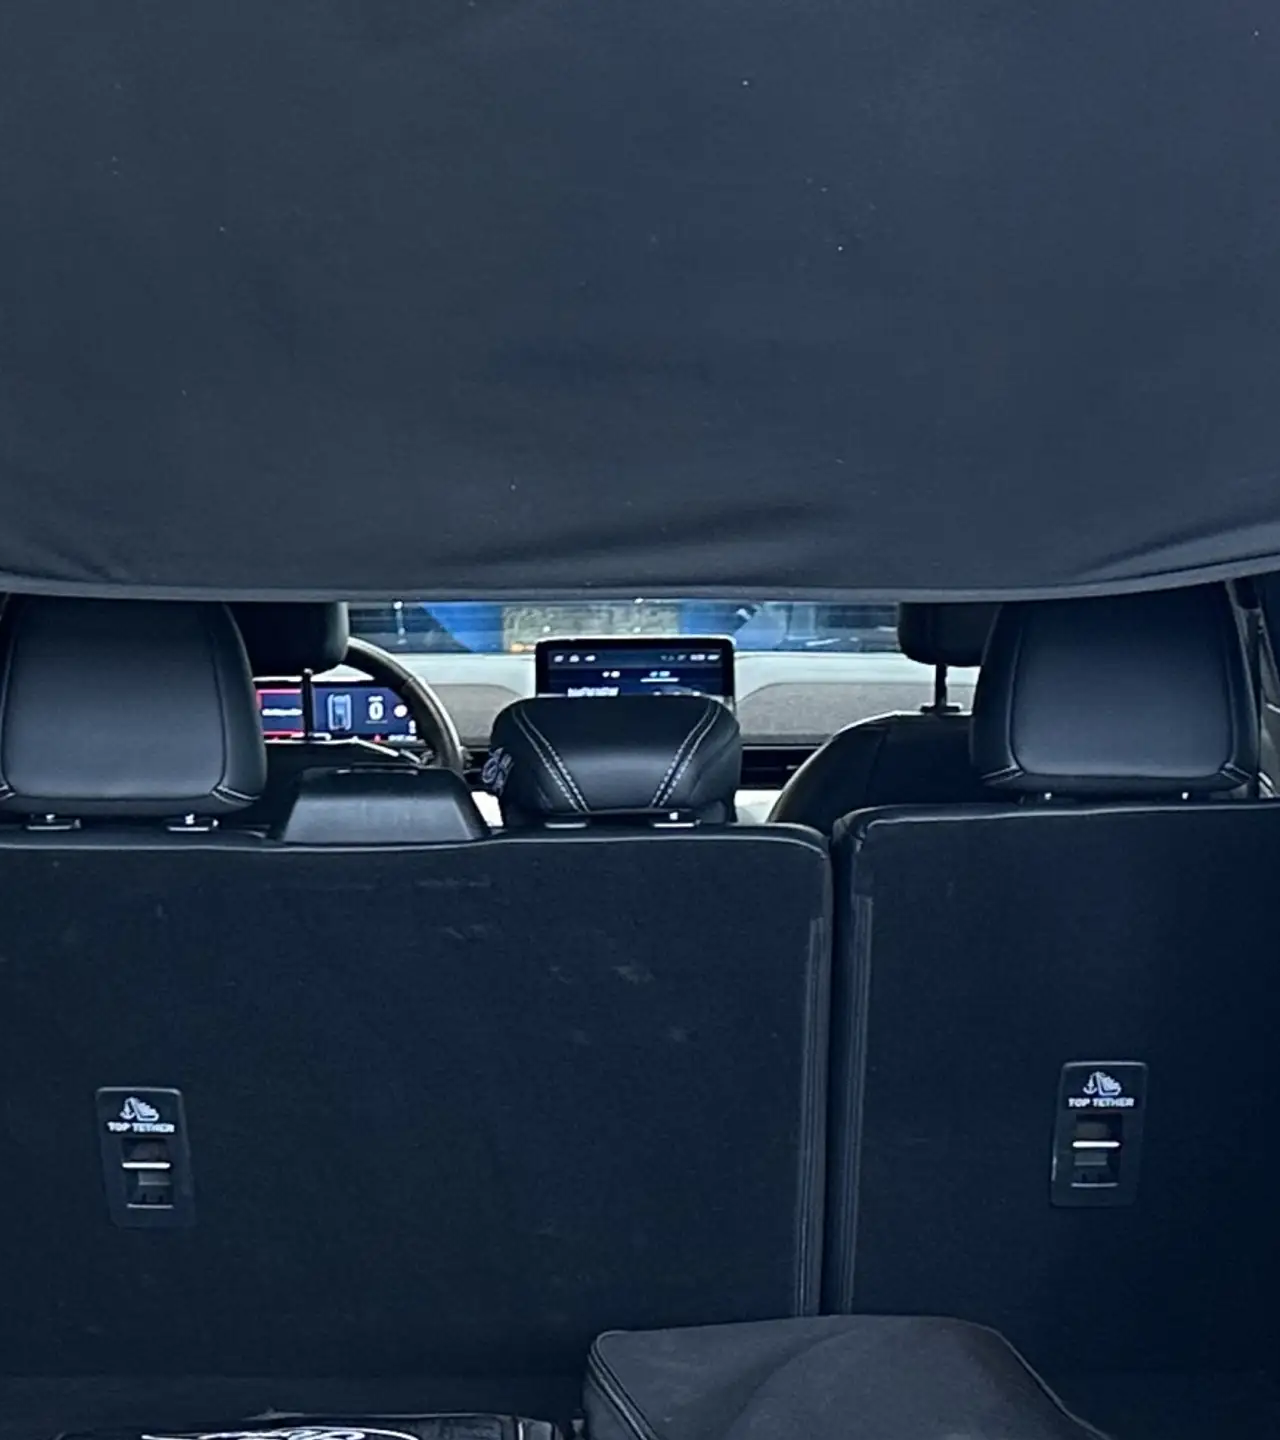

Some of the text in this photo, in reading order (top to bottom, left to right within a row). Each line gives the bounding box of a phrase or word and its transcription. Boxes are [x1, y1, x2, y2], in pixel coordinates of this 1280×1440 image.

[1068, 1097, 1135, 1108] TOP TETHER
[107, 1121, 175, 1133] TOP TETHER
